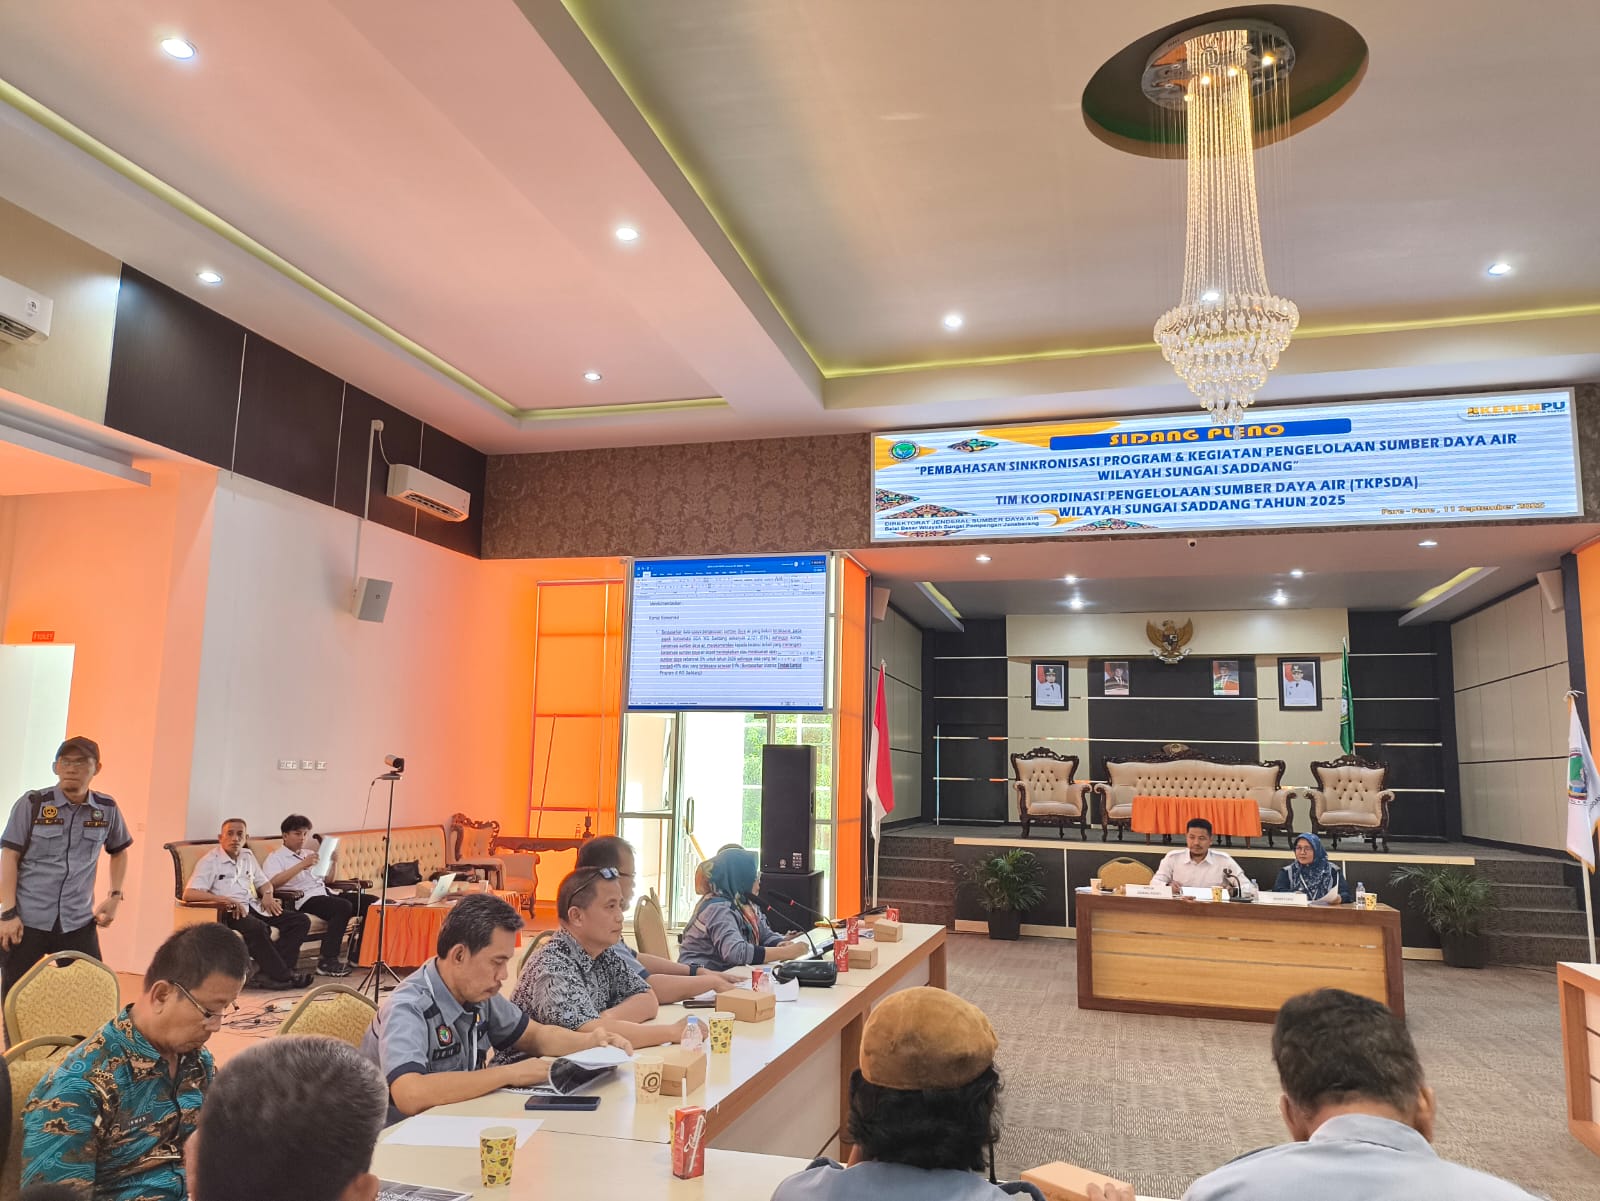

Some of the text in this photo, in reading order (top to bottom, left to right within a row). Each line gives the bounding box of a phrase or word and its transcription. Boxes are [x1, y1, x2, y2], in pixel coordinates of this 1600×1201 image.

[1109, 429, 1199, 446] SIDANG
[1009, 456, 1100, 471] SINKRONISASI
[1103, 452, 1172, 466] PROGRAM
[1175, 452, 1184, 462] &
[1188, 447, 1262, 461] KEGIATAN
[1266, 441, 1375, 457] PENGELOLAAN
[1379, 437, 1439, 451] SUMBER
[1443, 435, 1486, 447] DAYA
[1490, 433, 1517, 445] AIR
[1098, 468, 1161, 481] WILAYAH
[1165, 465, 1218, 478] SUNGAI
[995, 476, 1418, 505] TIM KOORDINASI PENGELOLAAN SUMBER DAYA AIR (TKPSDA)
[1059, 494, 1345, 517] WILAYAH SUNGAI SADDANG TAHUN 2025
